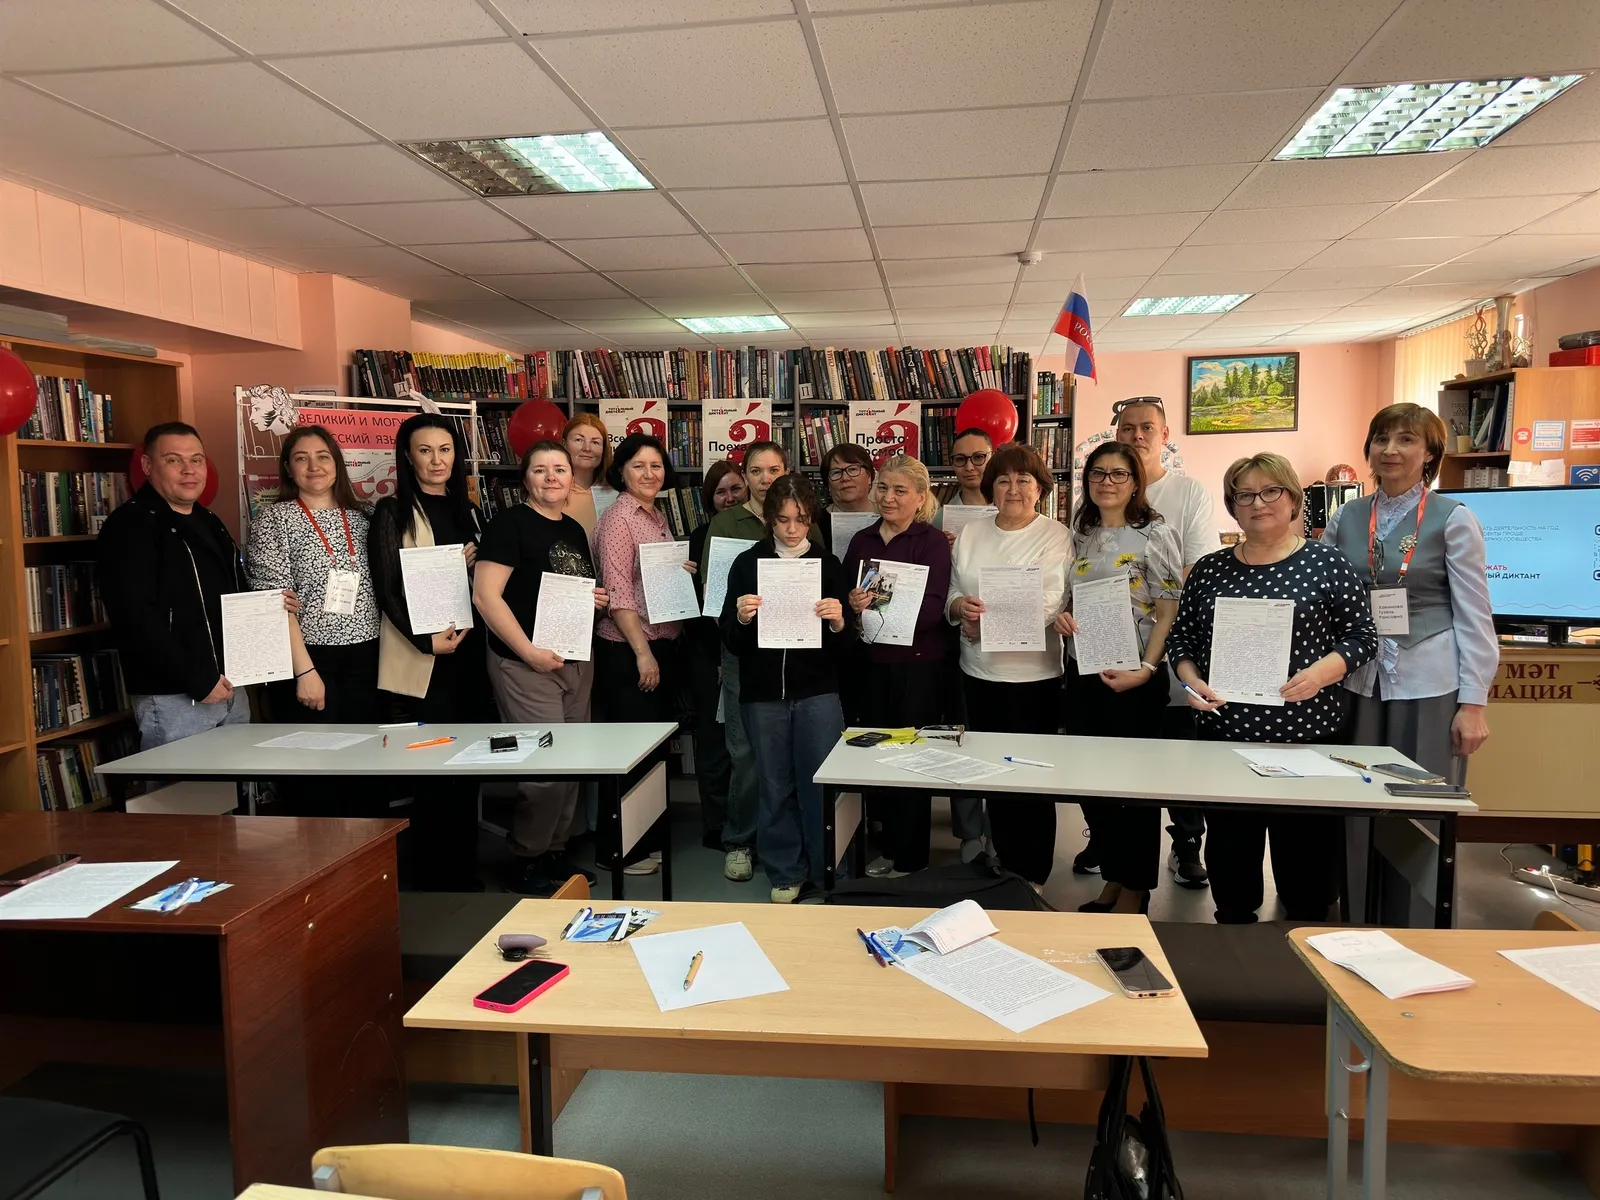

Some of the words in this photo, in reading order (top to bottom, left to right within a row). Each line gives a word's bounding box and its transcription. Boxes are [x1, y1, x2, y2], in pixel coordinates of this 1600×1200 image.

[299, 413, 356, 425] ВЕЛИКИЙ
[360, 417, 368, 426] И
[372, 417, 404, 427] МОГУ
[332, 433, 370, 444] ССКИЙ
[855, 433, 905, 447] Просто
[708, 441, 747, 451] Поеха
[863, 448, 904, 456] осмос
[1497, 663, 1560, 679] МӘТ
[1488, 684, 1574, 701] МАЦИЯ
